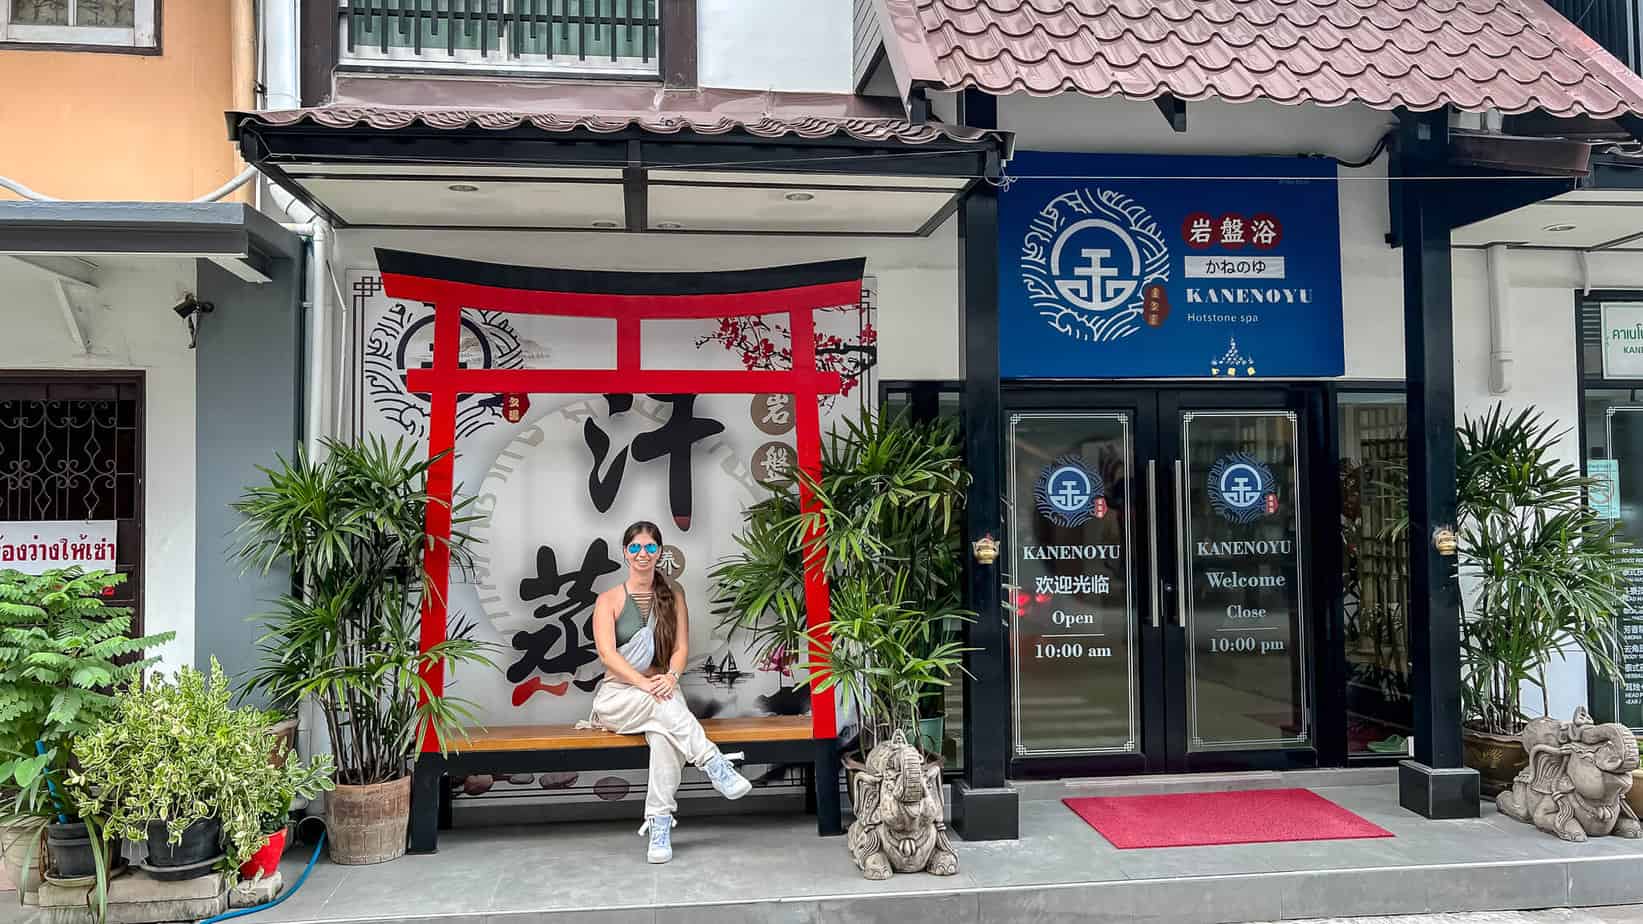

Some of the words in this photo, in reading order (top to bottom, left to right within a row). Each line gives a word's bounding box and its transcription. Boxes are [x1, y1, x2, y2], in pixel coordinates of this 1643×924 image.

[1189, 217, 1277, 244] 岩盤浴
[1205, 259, 1266, 275] かねのゆ
[1186, 288, 1313, 304] KANENOYU
[1187, 312, 1237, 323] Hotstone
[1240, 314, 1258, 324] spa
[0, 534, 115, 562] องว่างให้เช่า
[1023, 545, 1121, 560] KANENOYU
[1197, 540, 1292, 556] KANENOYU
[1035, 575, 1110, 594] 欢迎光临
[1206, 571, 1286, 588] Welcome
[1052, 610, 1094, 627] Open
[1227, 605, 1267, 619] Close
[1035, 643, 1083, 658] 10:00
[1087, 646, 1112, 657] am
[1210, 637, 1256, 652] 10:00
[1261, 639, 1285, 654] pm
